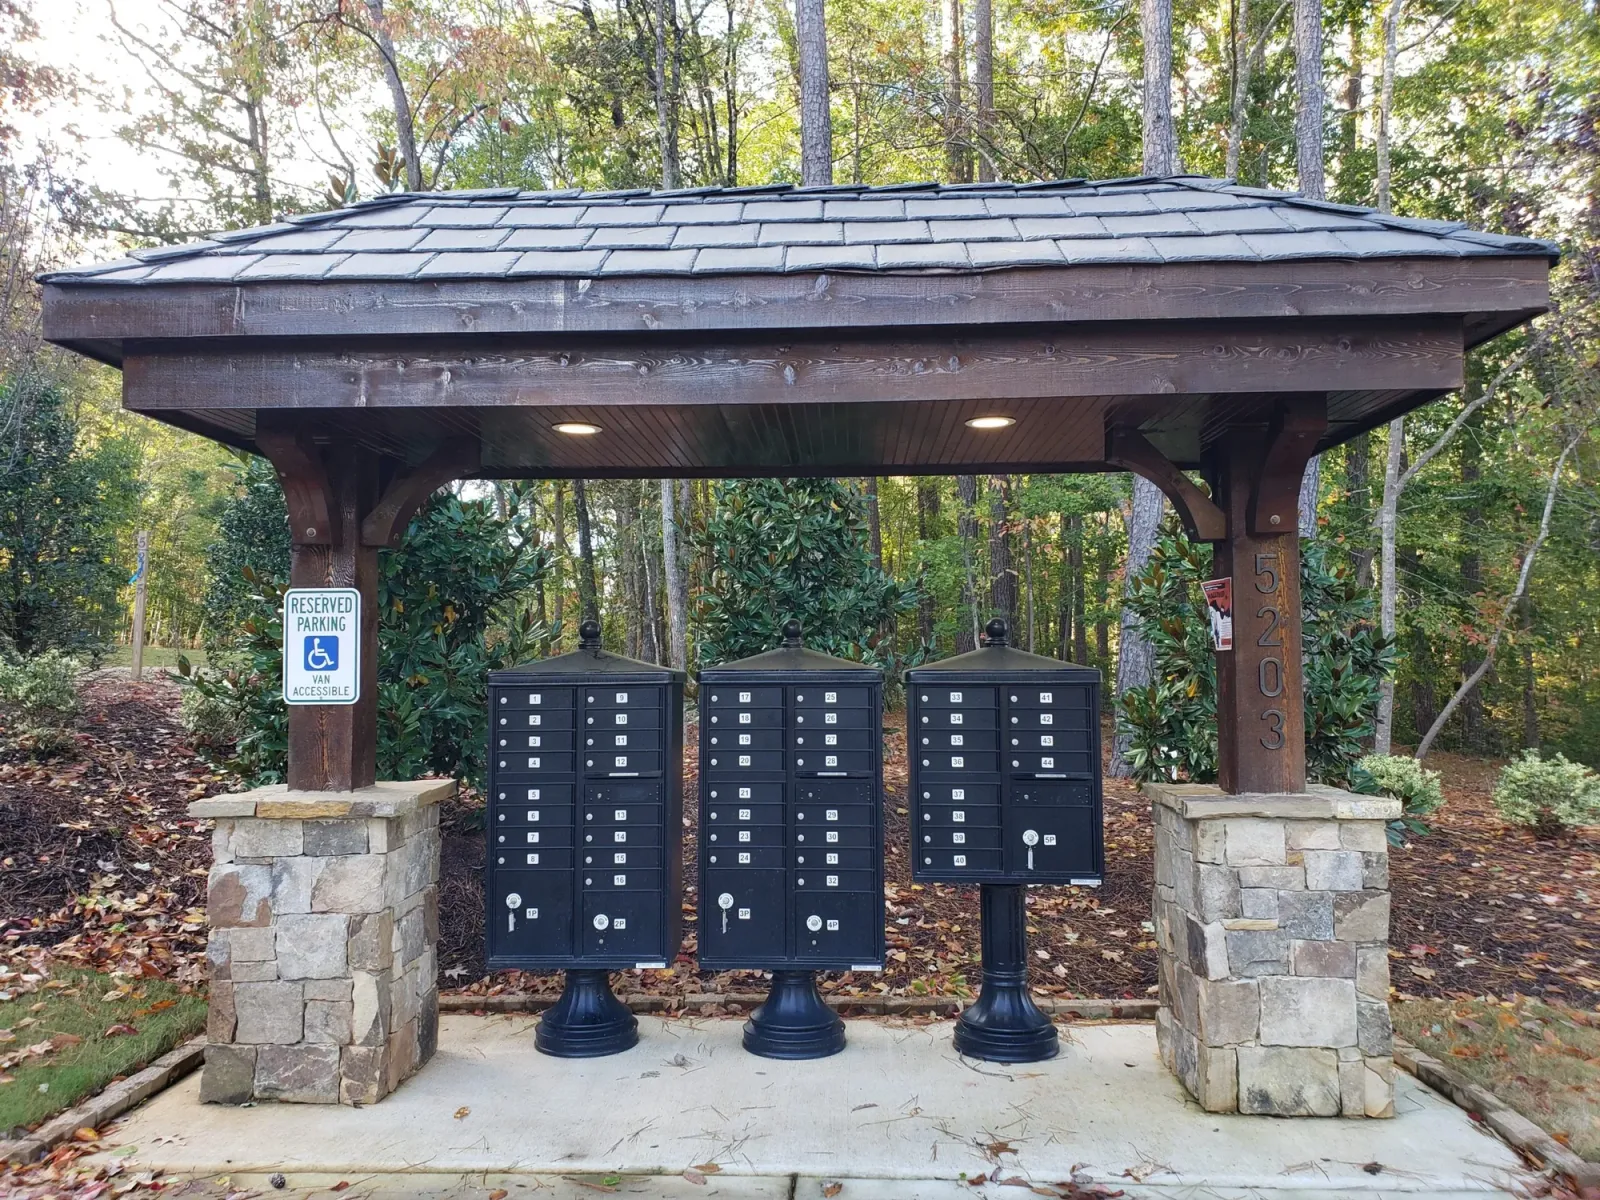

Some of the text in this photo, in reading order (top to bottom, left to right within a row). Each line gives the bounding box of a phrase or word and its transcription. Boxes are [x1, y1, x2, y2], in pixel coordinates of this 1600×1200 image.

[292, 597, 352, 614] RESERVED
[297, 617, 346, 631] PARKING
[312, 675, 330, 684] VAN
[293, 686, 349, 696] ACCESSIBLE
[740, 693, 750, 701] 17
[826, 693, 836, 701] 25
[951, 693, 961, 701] 33
[617, 715, 626, 723] 10
[740, 714, 750, 722] 18
[826, 714, 836, 722] 26
[1041, 715, 1052, 723] 42
[740, 735, 750, 743] 19
[826, 735, 836, 744] 27
[952, 736, 962, 744] 35
[1042, 737, 1052, 745] 43
[616, 757, 626, 766] 12
[740, 756, 750, 765] 20
[826, 757, 836, 765] 28
[952, 758, 963, 766] 36
[740, 789, 749, 797] 21
[953, 790, 963, 798] 37
[616, 811, 626, 819] 13
[740, 810, 750, 818] 22
[827, 811, 837, 819] 29
[954, 812, 964, 820] 38
[740, 832, 750, 840] 23
[827, 833, 837, 841] 30
[954, 834, 964, 842] 39
[1044, 836, 1055, 844] 5P
[616, 854, 625, 862] 15
[740, 854, 749, 862] 24
[827, 854, 837, 862] 31
[955, 856, 965, 864] 40
[615, 876, 625, 884] 16
[828, 876, 837, 885] 32
[527, 909, 537, 917] 1P
[739, 909, 750, 917] 3P
[614, 920, 625, 928] 2P
